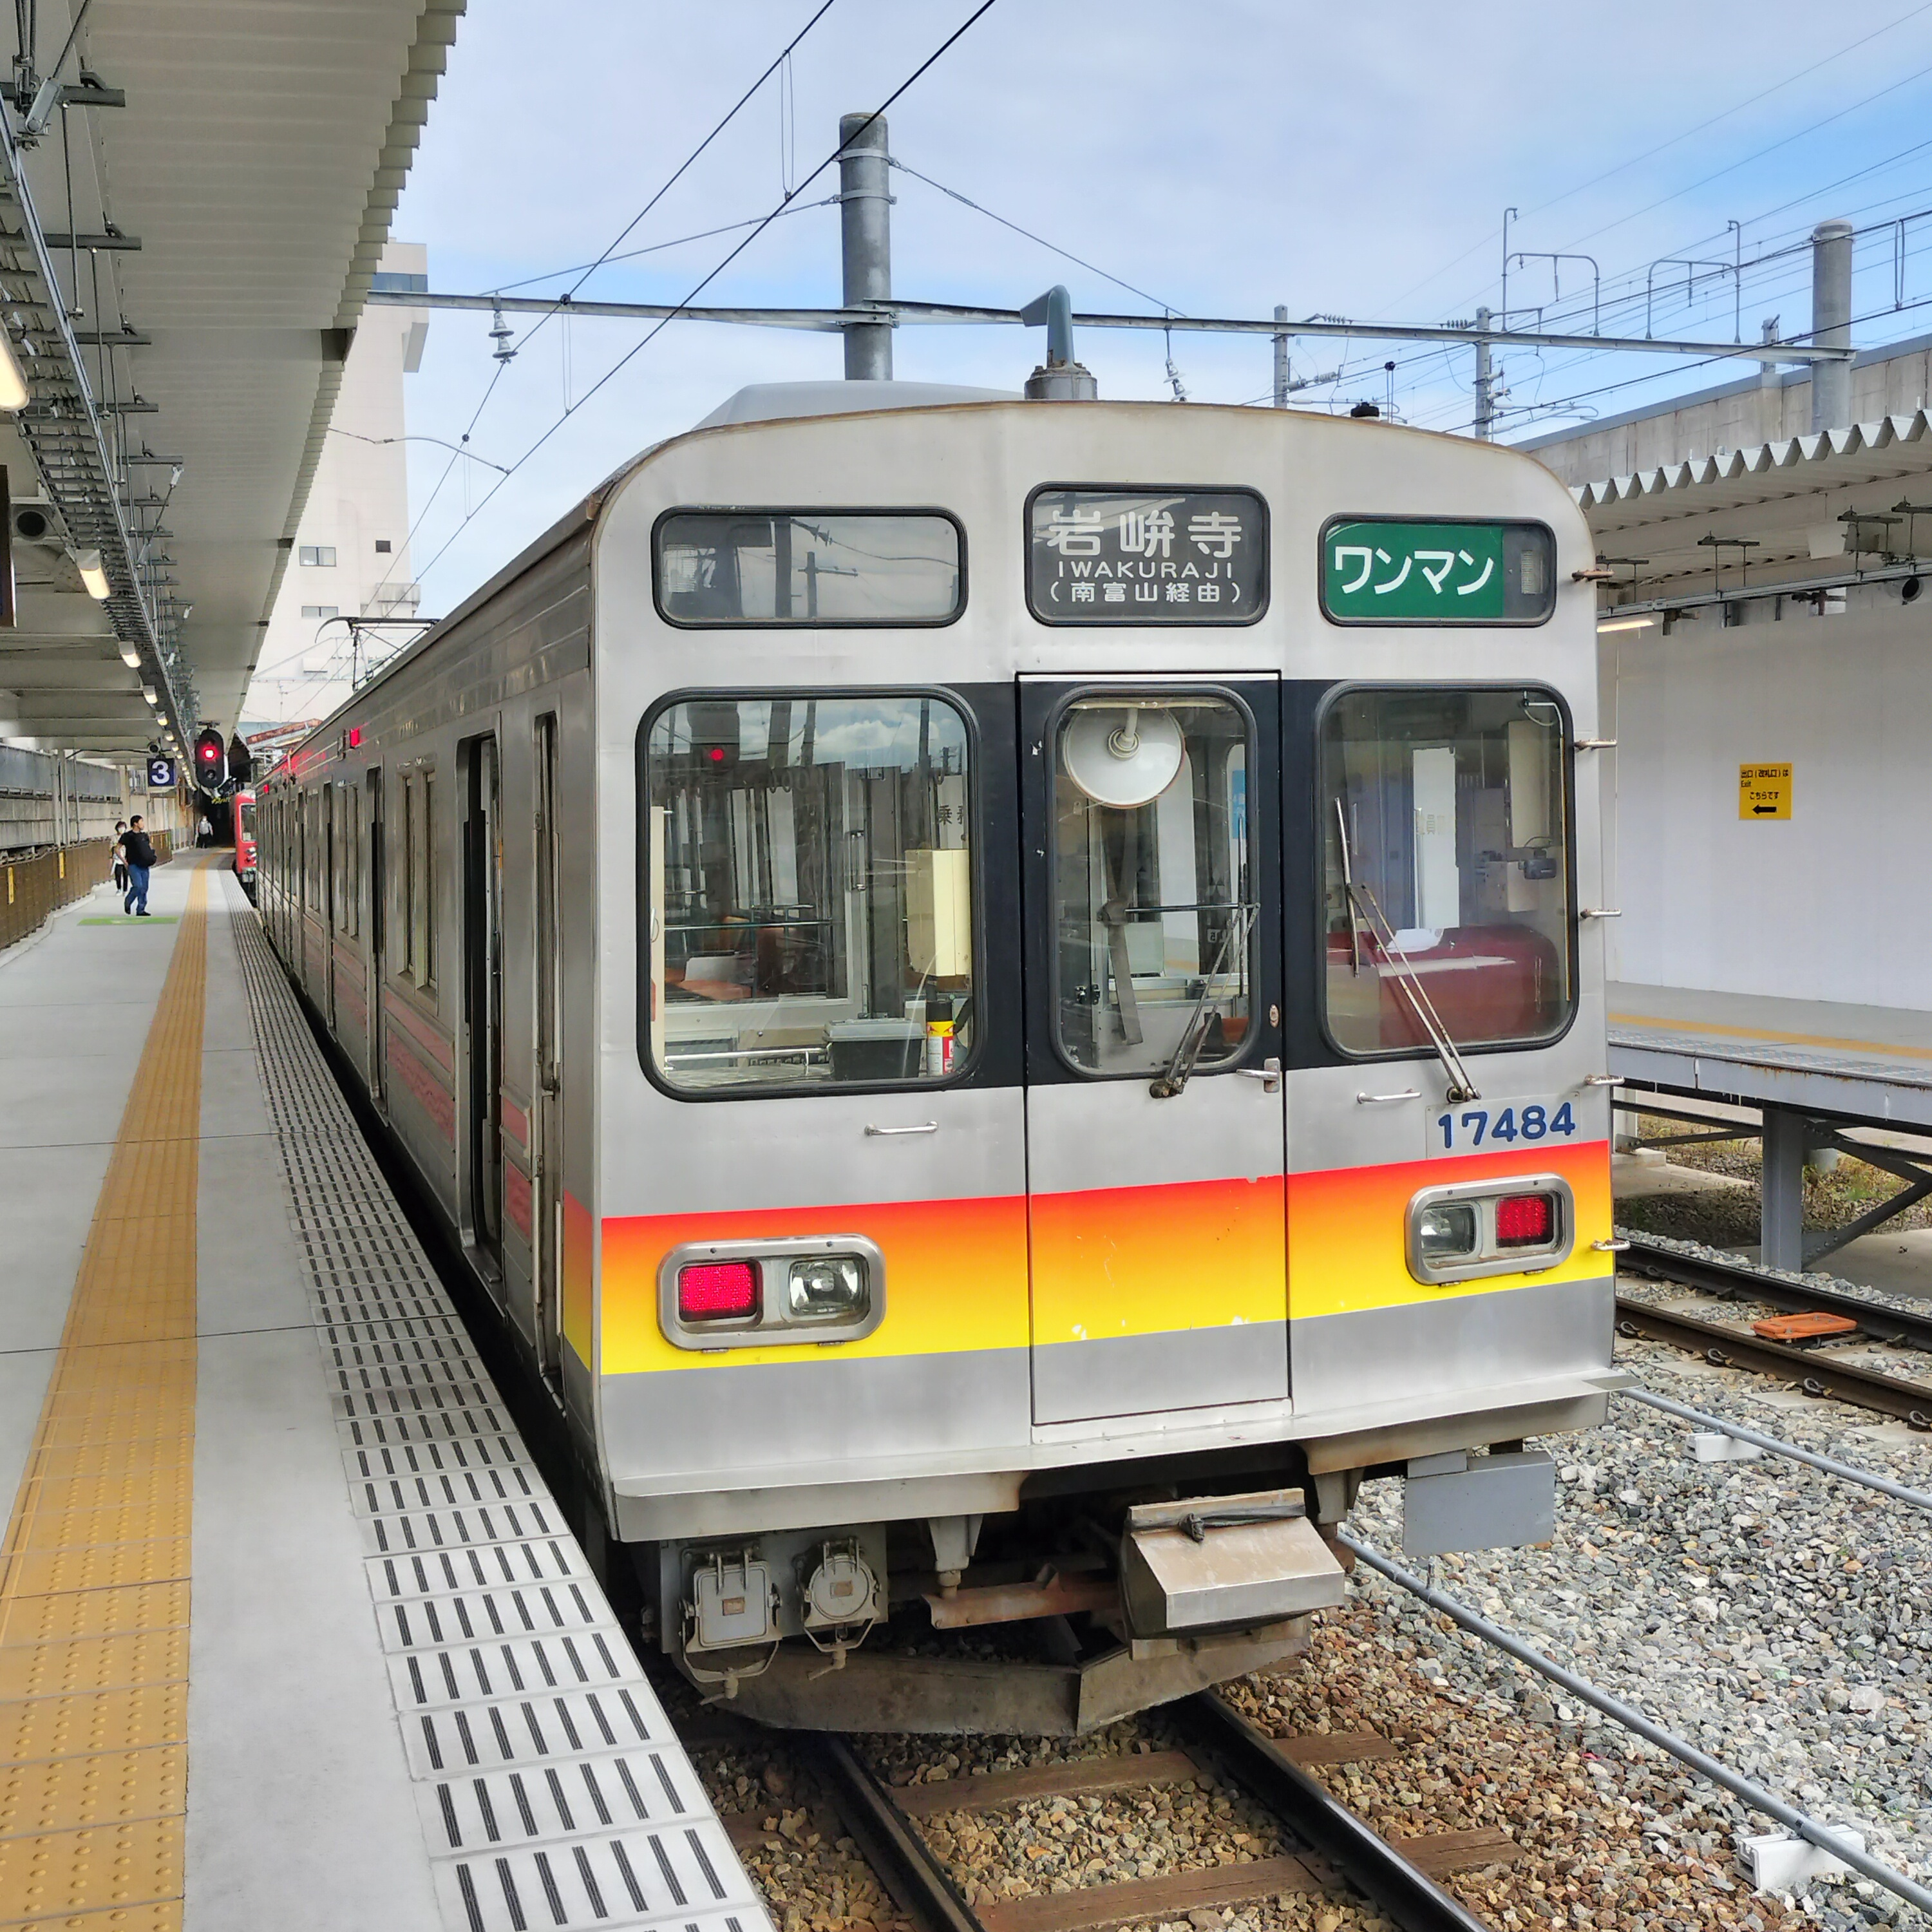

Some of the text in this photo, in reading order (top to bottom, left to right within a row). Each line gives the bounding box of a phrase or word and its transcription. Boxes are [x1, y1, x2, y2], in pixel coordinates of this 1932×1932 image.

[1046, 509, 1242, 558] 岩峅寺
[1058, 560, 1232, 578] IWAKURAJI
[1335, 546, 1494, 595] ワンマン
[151, 761, 170, 784] 3
[1749, 791, 1779, 800] こちらです
[1438, 1102, 1576, 1148] 17484
